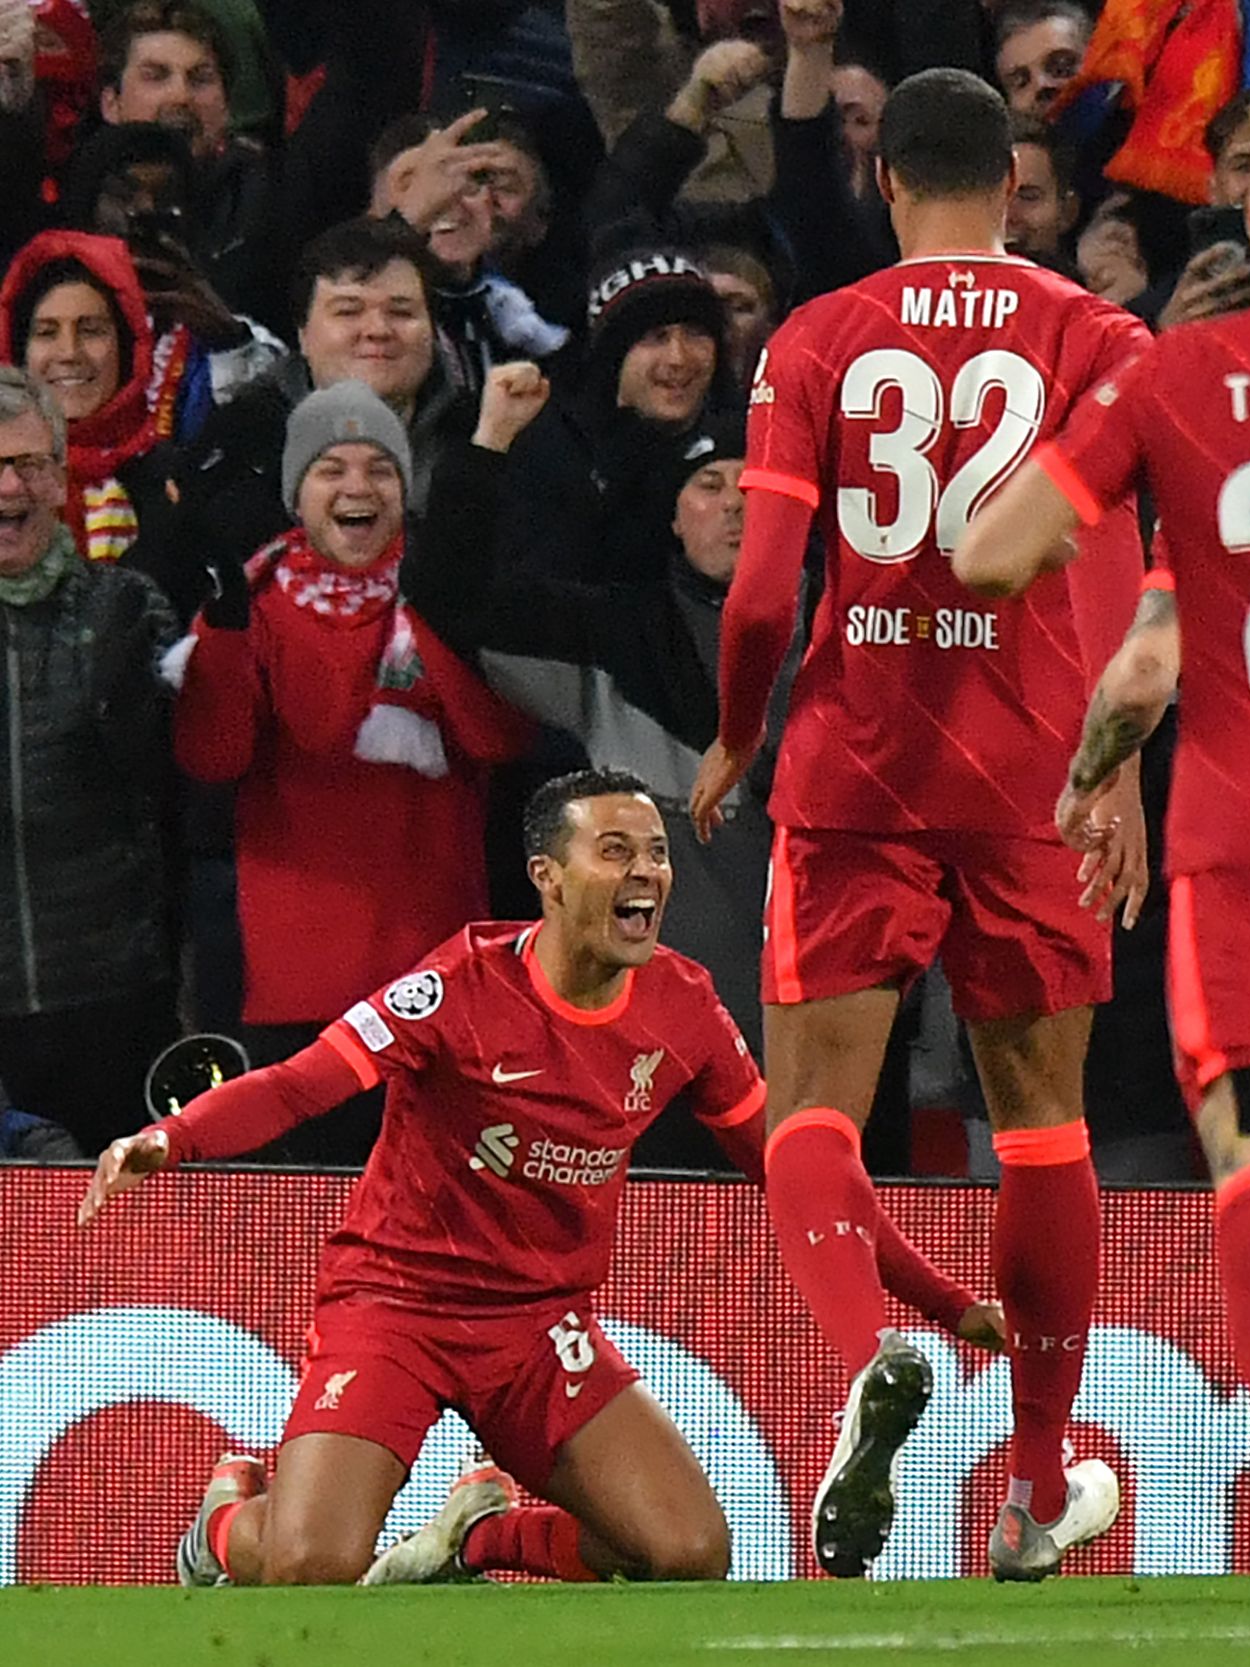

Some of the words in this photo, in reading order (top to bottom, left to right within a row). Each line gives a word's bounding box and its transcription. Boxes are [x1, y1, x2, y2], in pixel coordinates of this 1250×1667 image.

[901, 286, 1019, 329] MATIP
[837, 348, 1046, 564] 32
[846, 604, 911, 646] SIDE
[935, 607, 999, 650] SIDE
